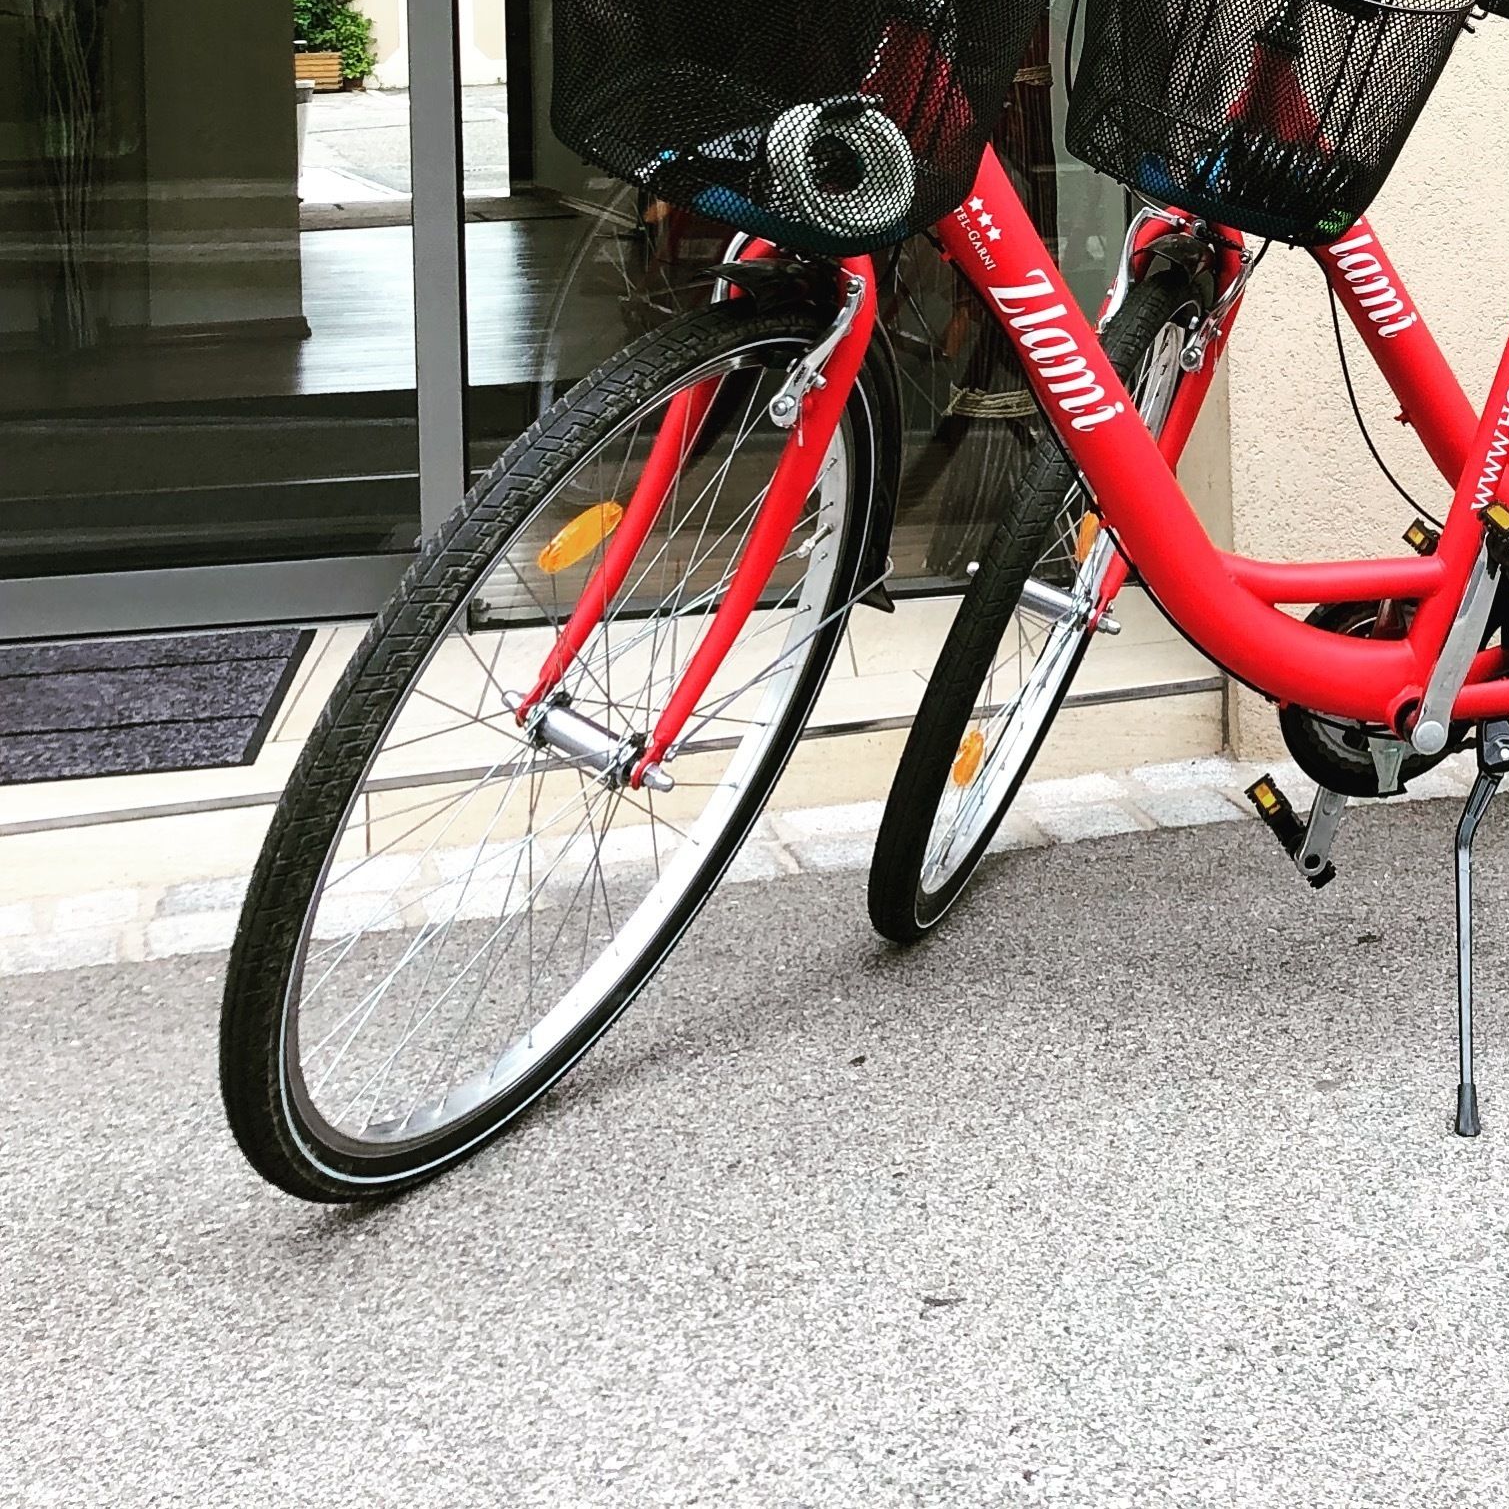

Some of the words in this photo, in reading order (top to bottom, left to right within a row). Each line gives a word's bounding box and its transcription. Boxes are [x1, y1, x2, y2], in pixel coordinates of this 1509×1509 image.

[953, 205, 997, 271] TEL-GARNI
[1328, 217, 1418, 338] lami
[988, 268, 1125, 432] Zlami
